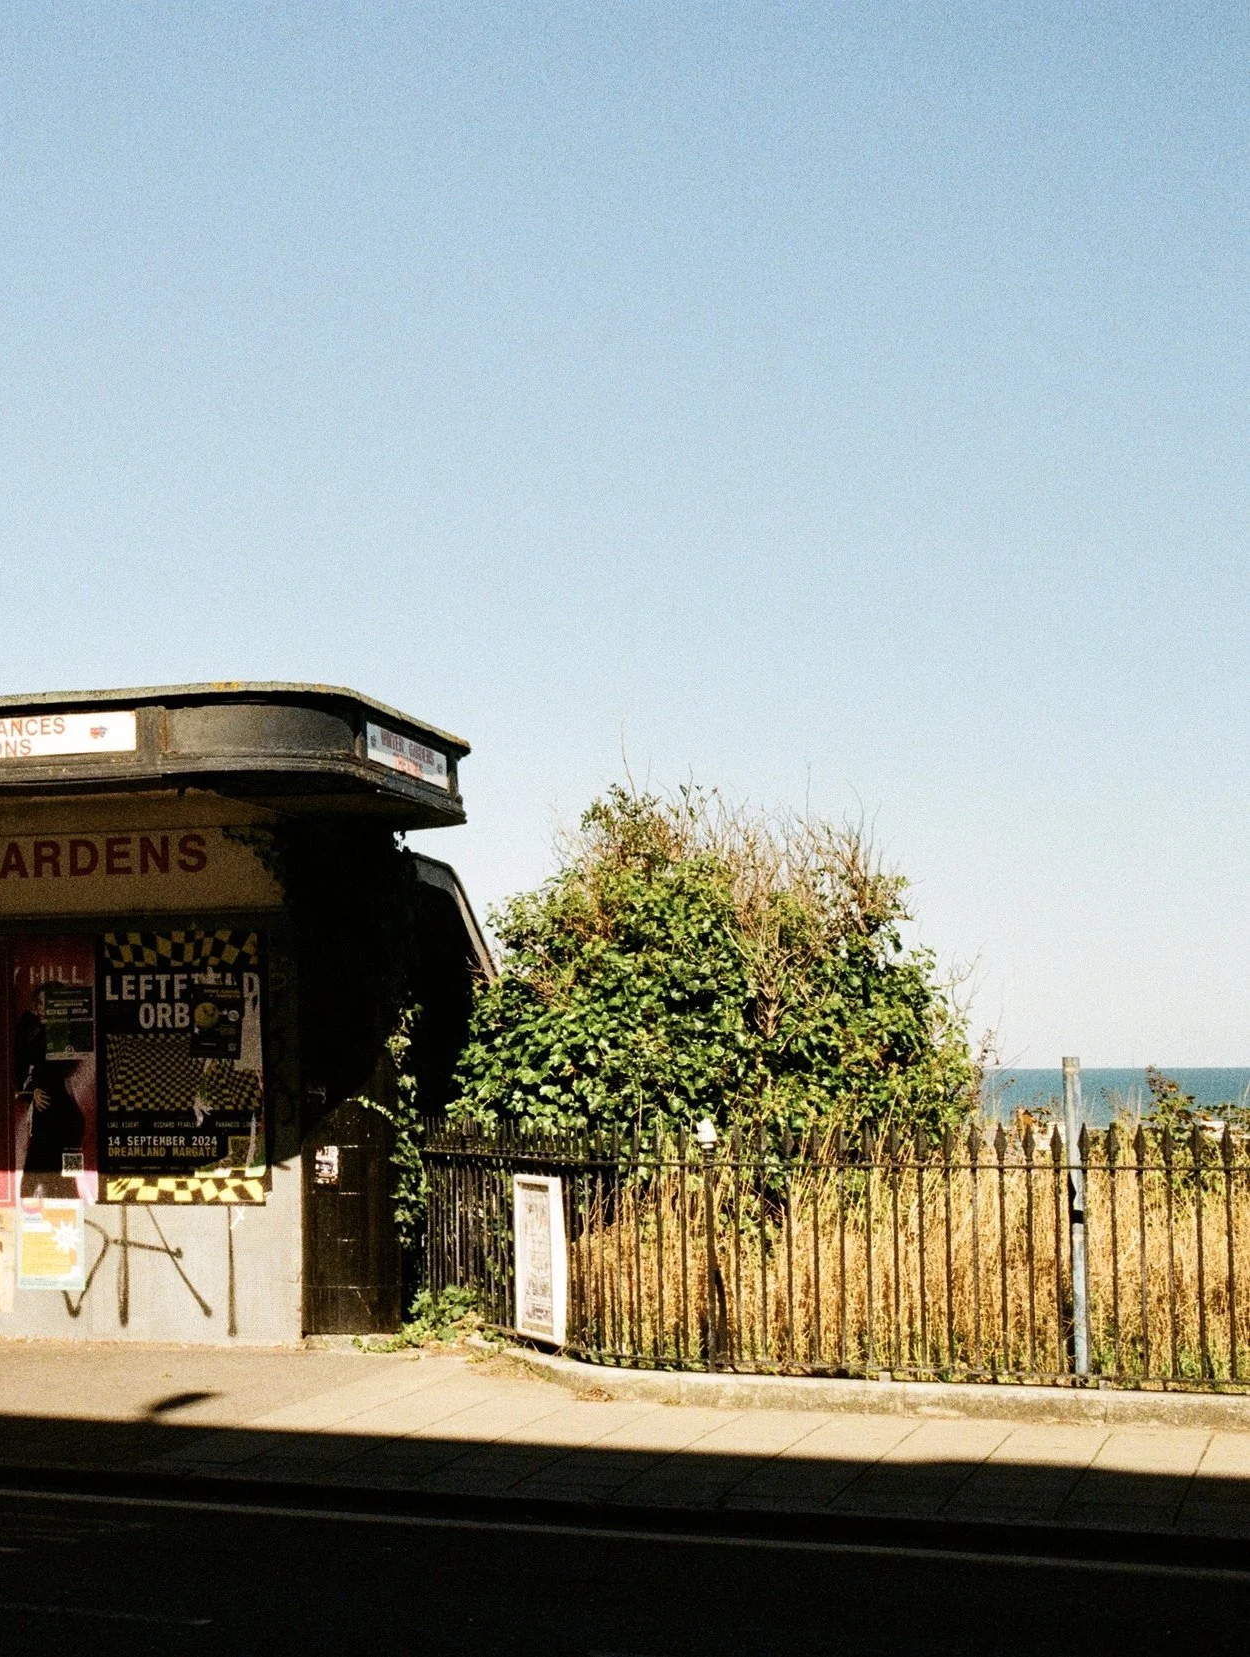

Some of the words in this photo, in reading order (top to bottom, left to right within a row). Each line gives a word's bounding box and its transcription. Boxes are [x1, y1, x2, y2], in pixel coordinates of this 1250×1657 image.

[138, 1001, 190, 1030] ORB
[107, 1135, 121, 1146] 14
[127, 1135, 186, 1146] SEPTEMBER
[192, 1135, 218, 1146] 2024
[107, 1147, 167, 1157] DREAMLAND
[172, 1147, 218, 1157] MARGATE
